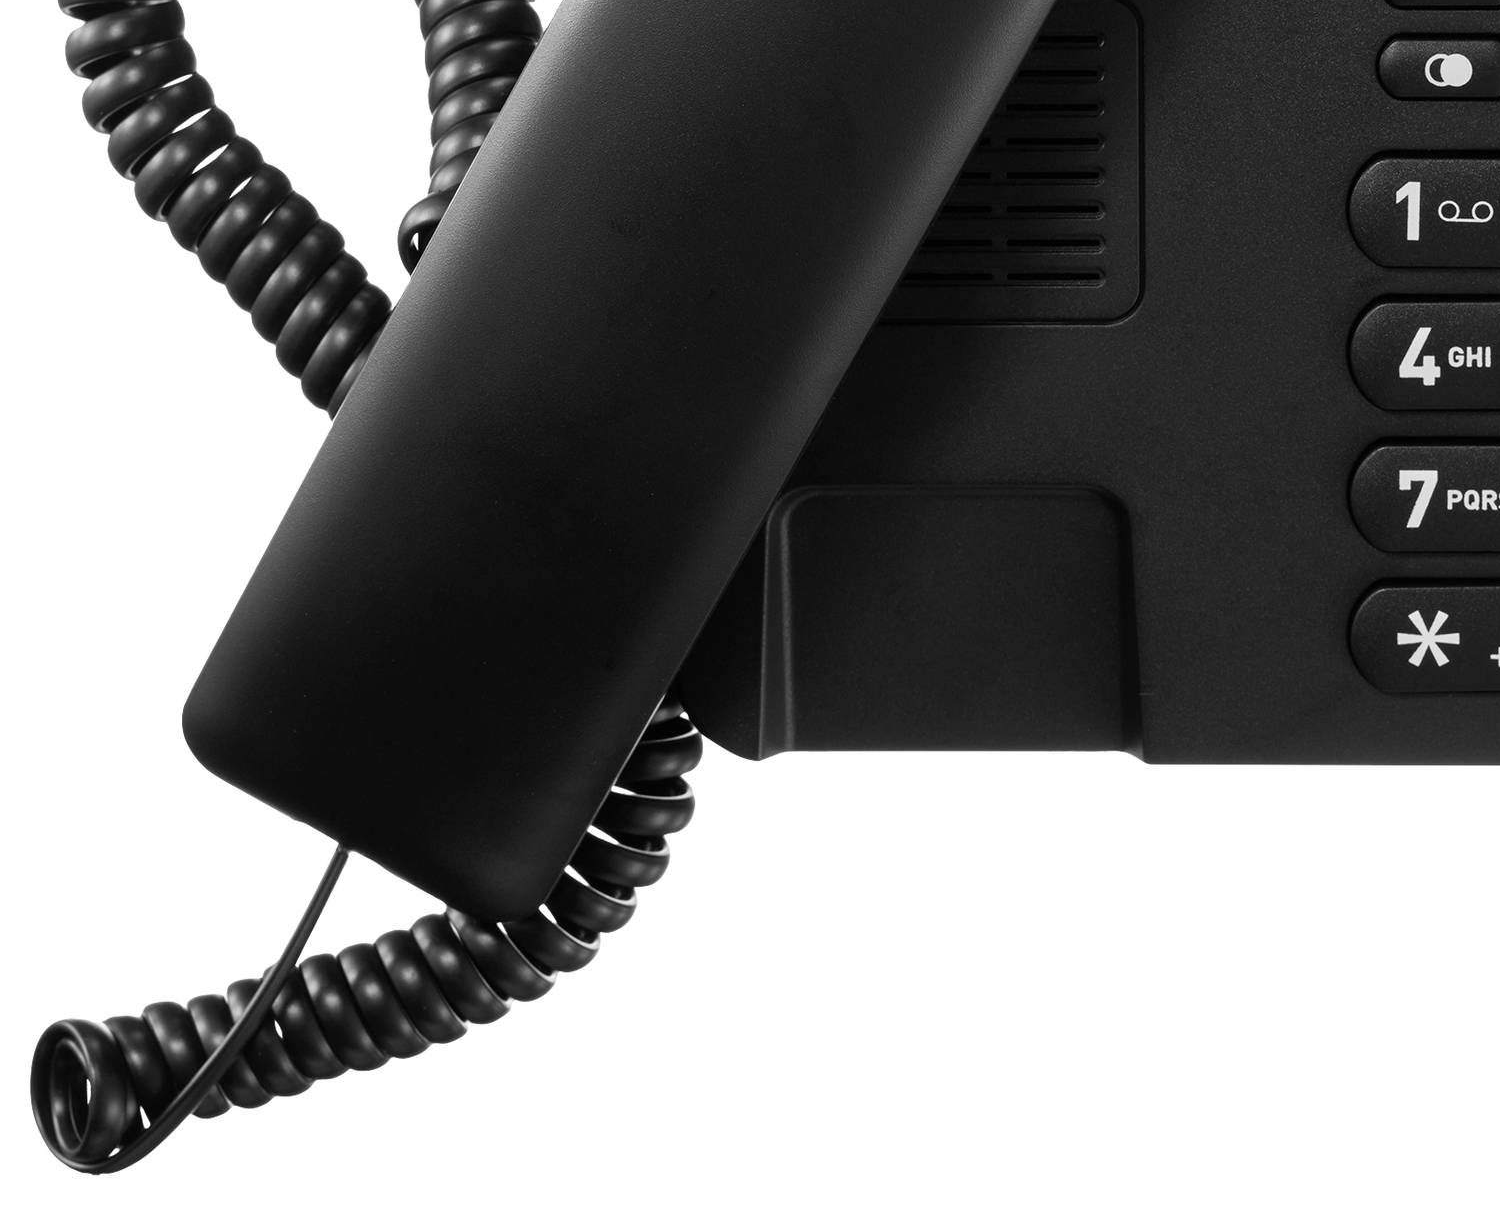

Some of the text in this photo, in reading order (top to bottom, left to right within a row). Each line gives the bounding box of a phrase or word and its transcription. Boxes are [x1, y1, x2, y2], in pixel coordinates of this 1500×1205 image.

[1395, 181, 1421, 242] 1
[1398, 326, 1492, 387] 4 GHI
[1398, 469, 1439, 529] 7
